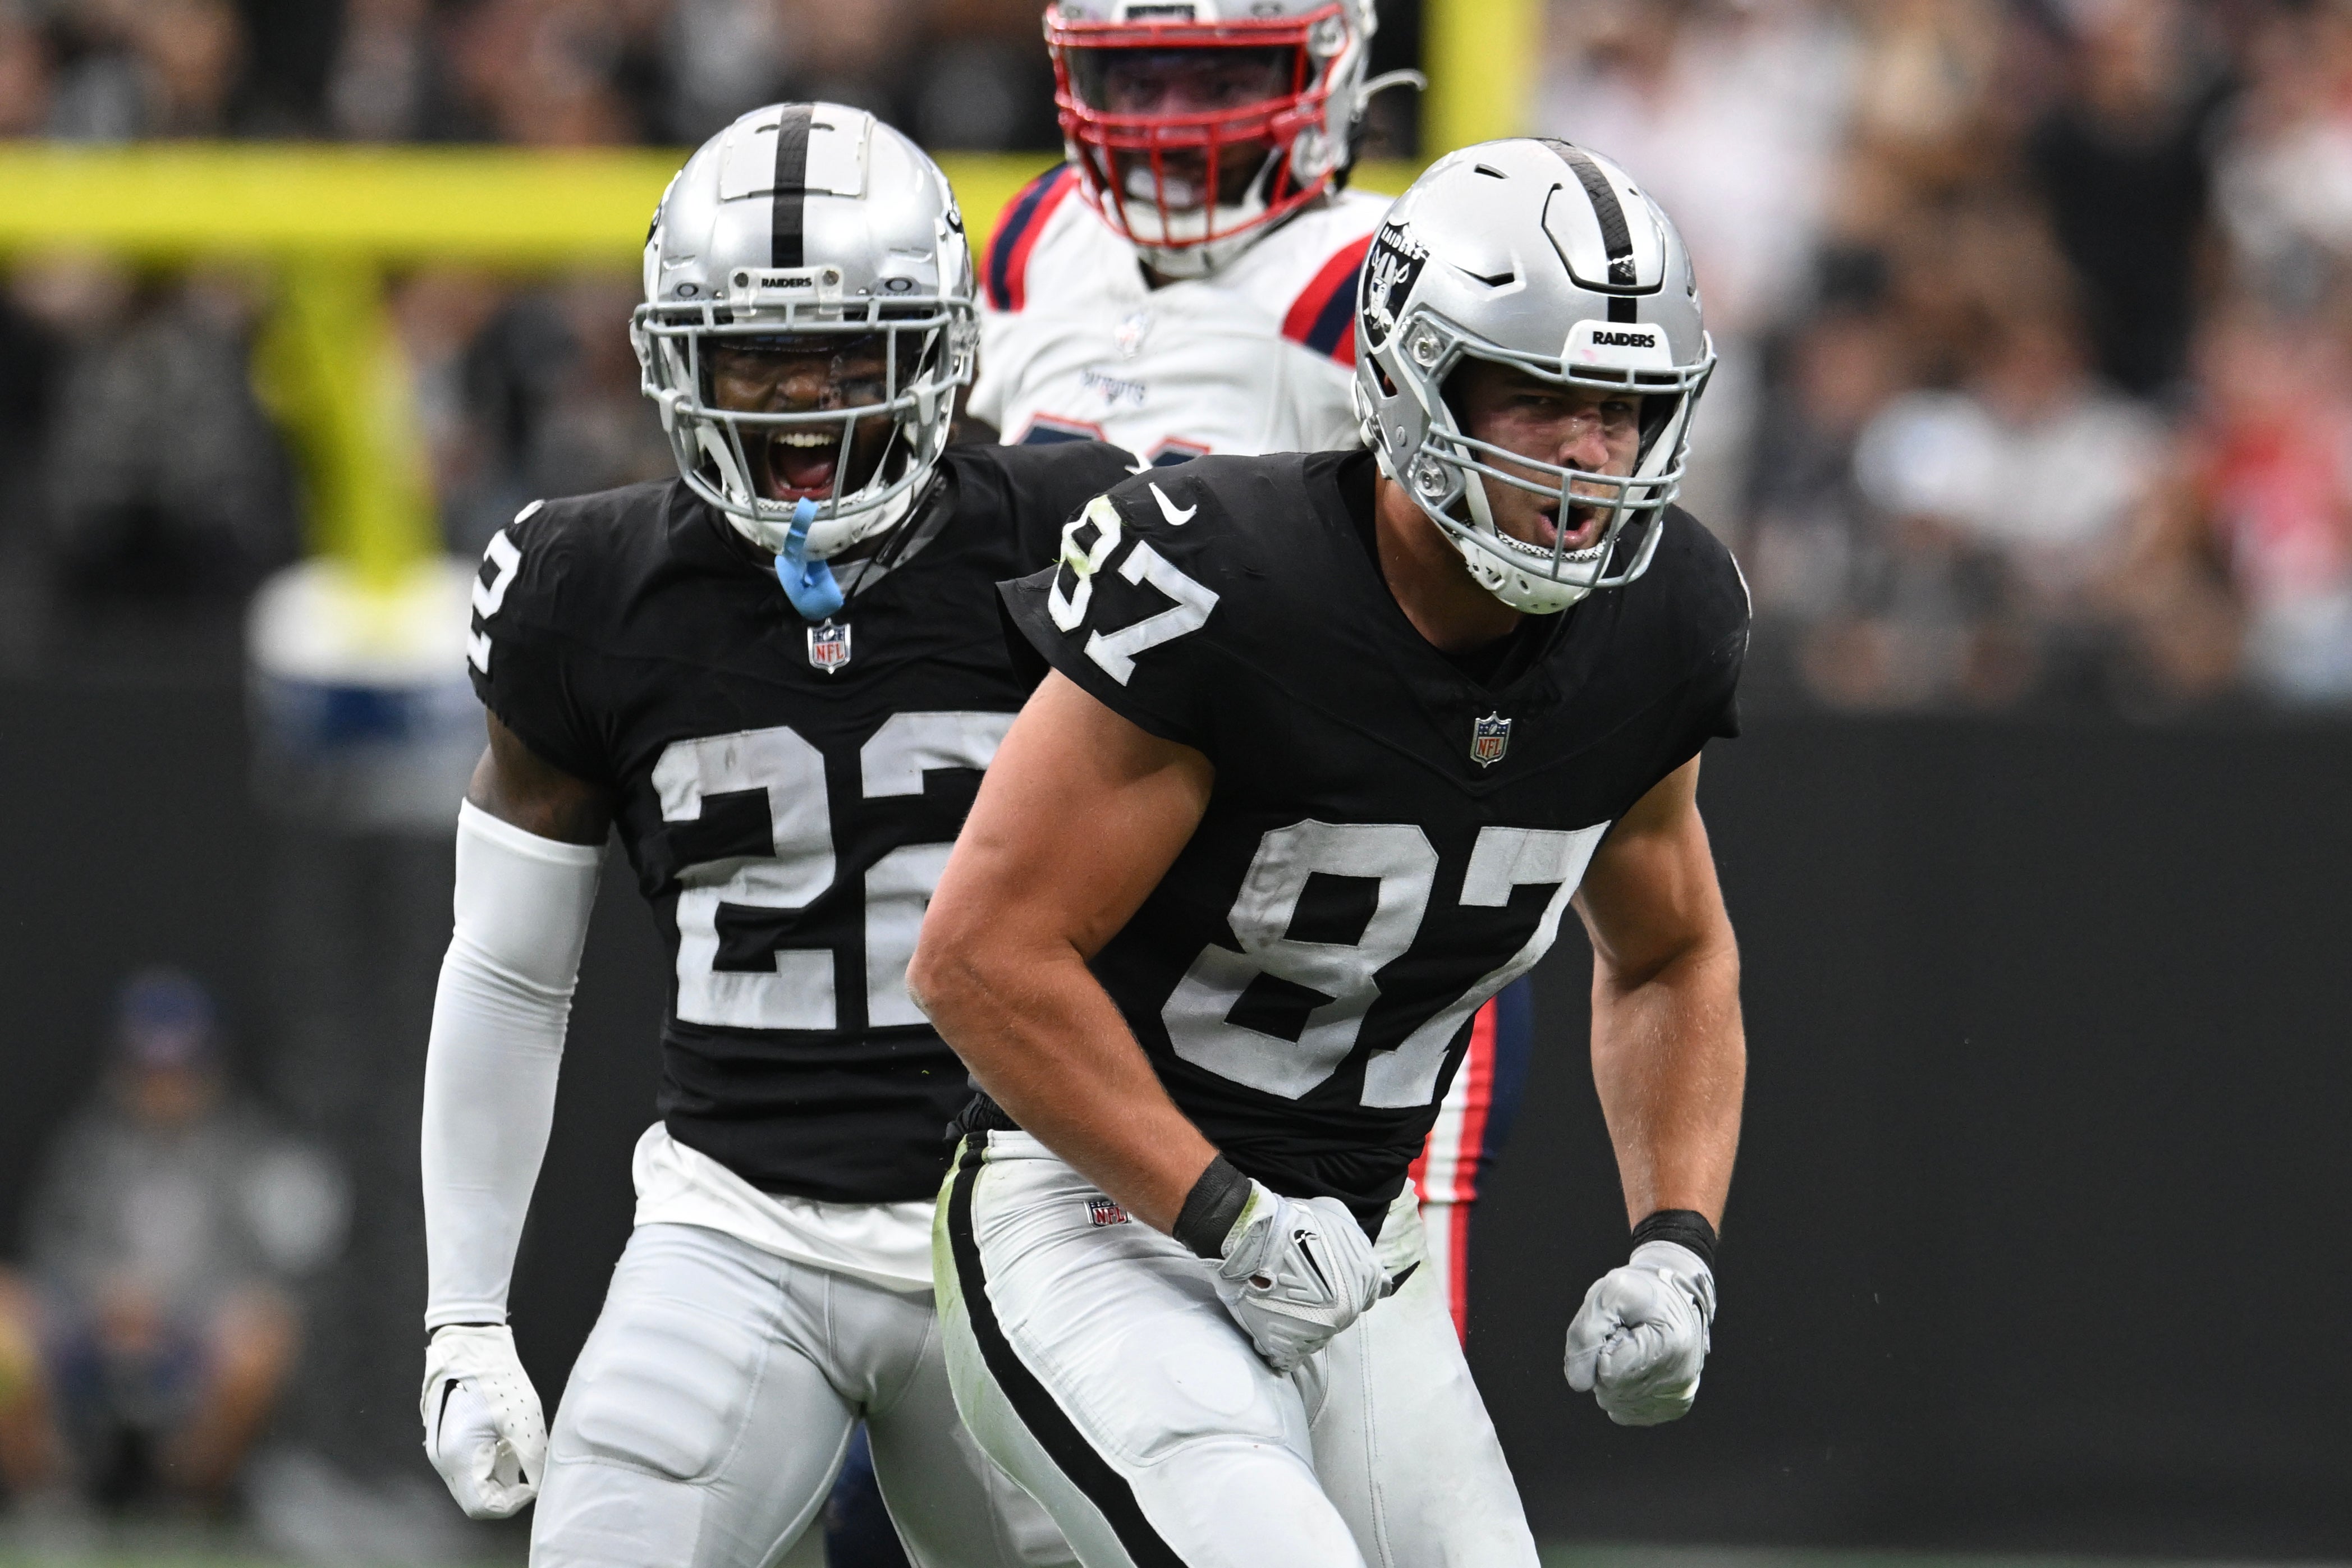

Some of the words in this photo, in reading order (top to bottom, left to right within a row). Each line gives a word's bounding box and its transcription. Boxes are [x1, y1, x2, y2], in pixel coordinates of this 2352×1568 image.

[762, 277, 812, 288] RAIDERS
[1593, 331, 1655, 348] RAIDERS
[1048, 494, 1220, 686] 87
[816, 643, 844, 662] NFL
[1477, 738, 1501, 758] NFL
[1160, 818, 1612, 1108] 87
[1094, 1207, 1125, 1225] NFL
